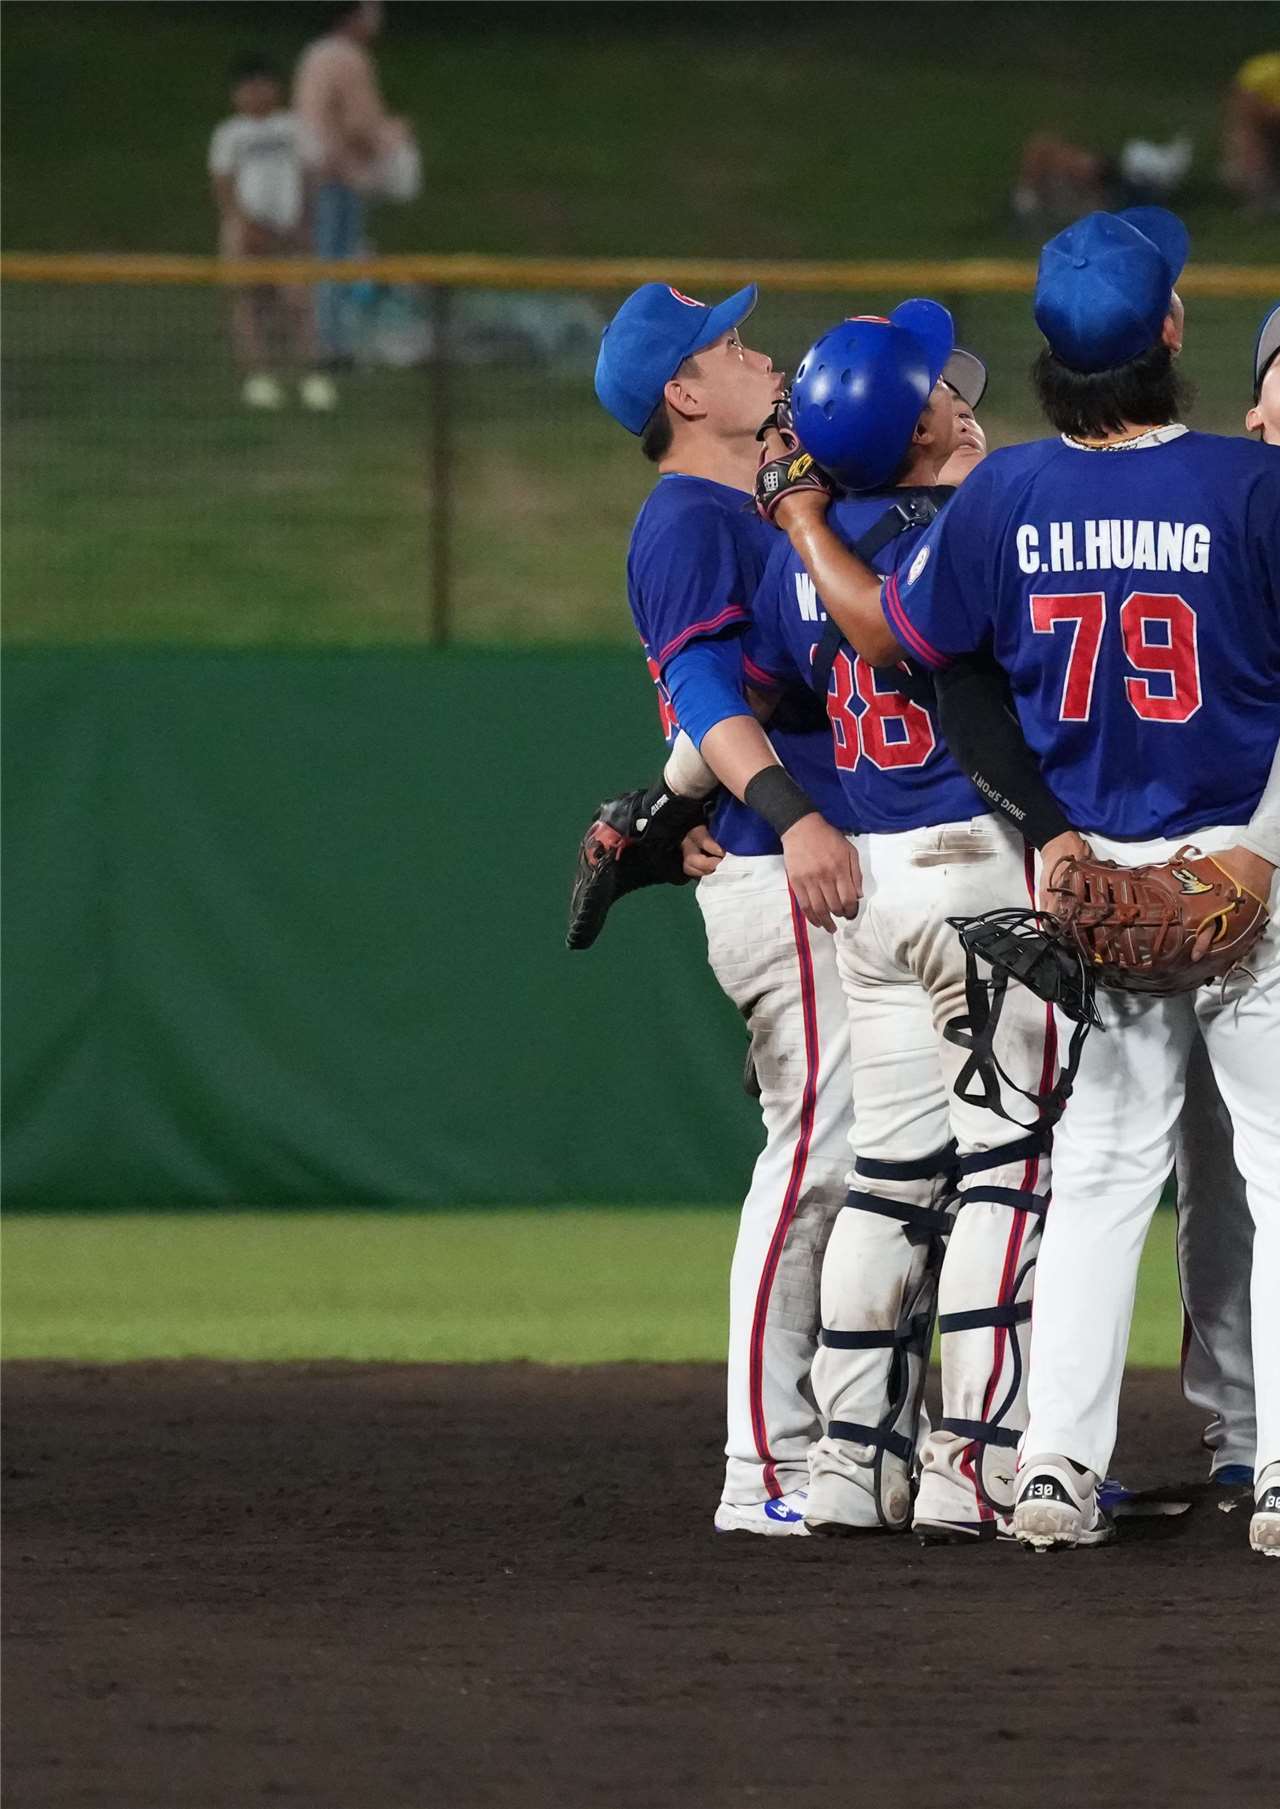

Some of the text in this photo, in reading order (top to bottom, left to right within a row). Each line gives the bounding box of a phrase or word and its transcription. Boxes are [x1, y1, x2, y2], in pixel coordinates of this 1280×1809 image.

[1016, 519, 1211, 574] C.H.HUANG
[1029, 591, 1203, 723] 79
[971, 771, 1027, 821] SNUG SPORT
